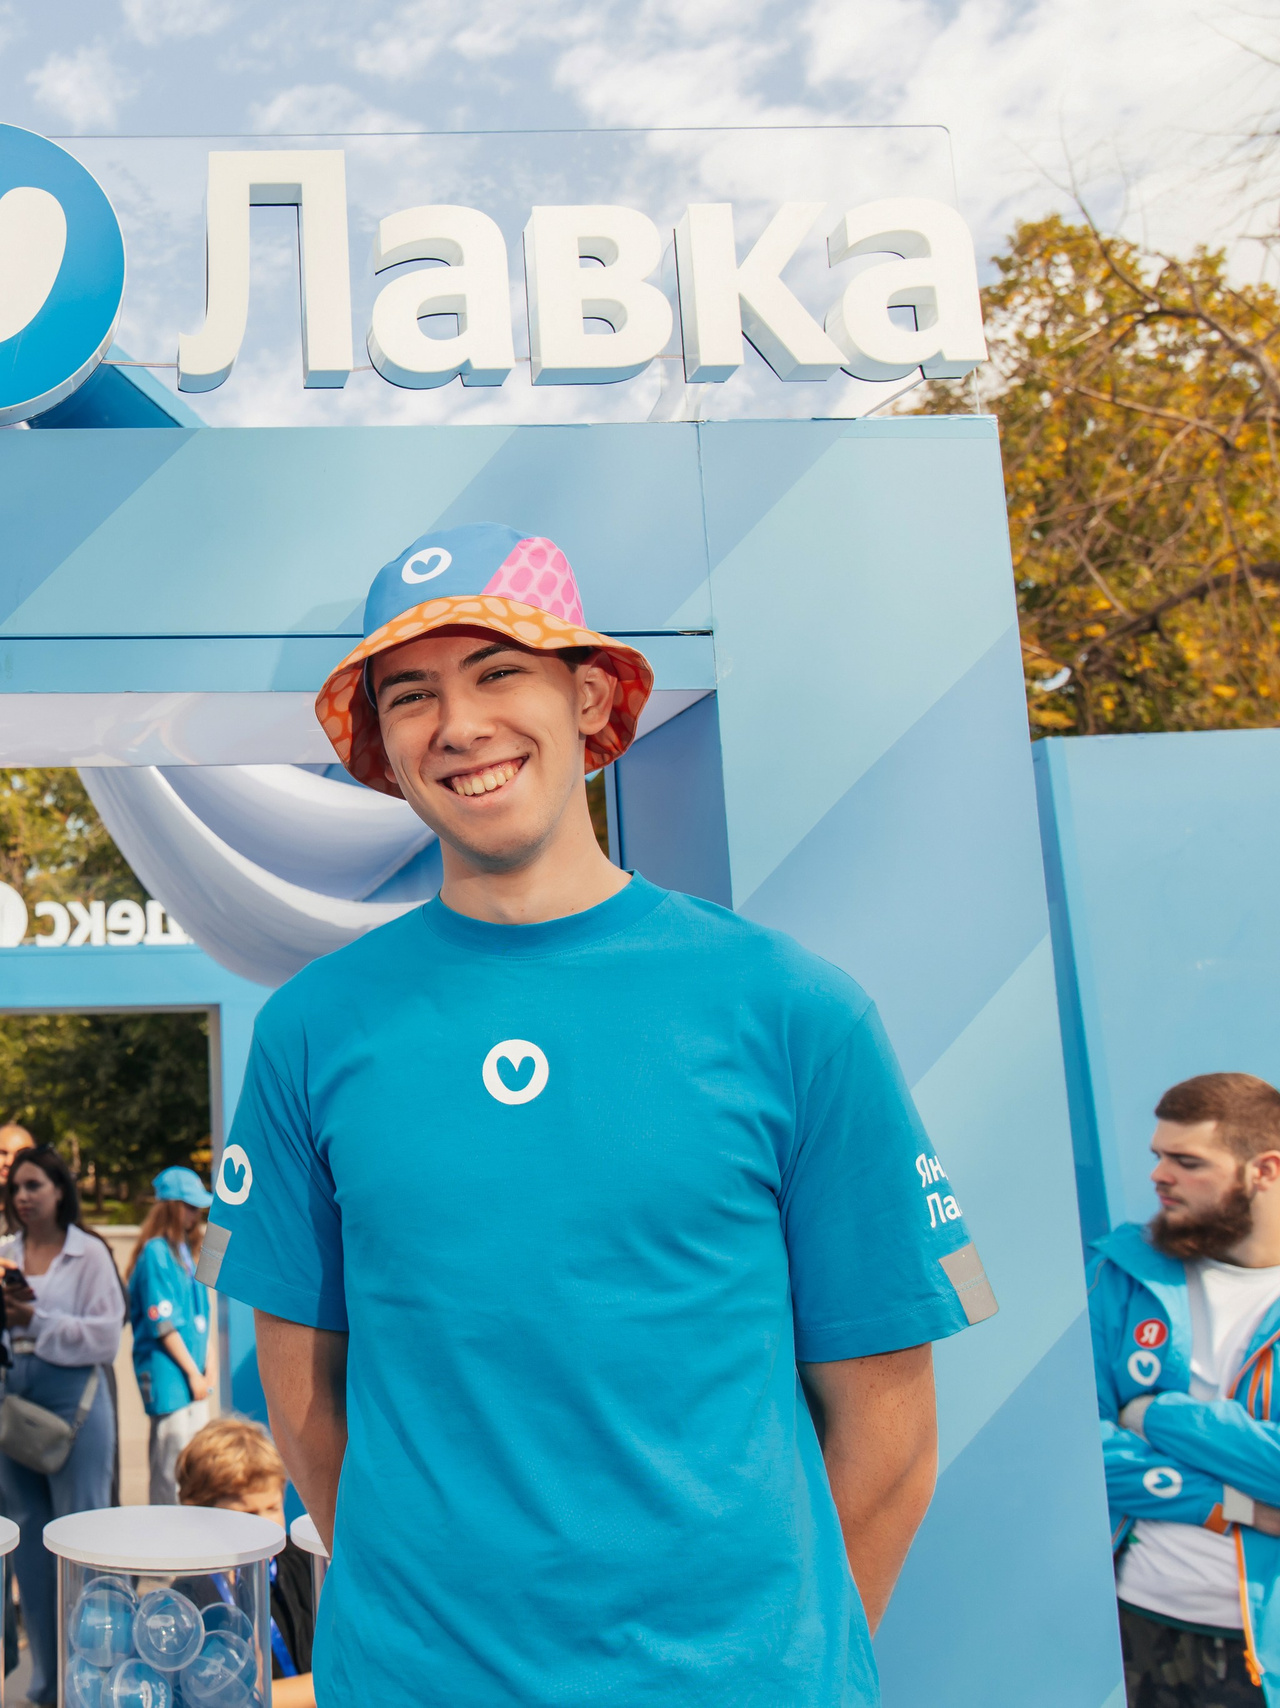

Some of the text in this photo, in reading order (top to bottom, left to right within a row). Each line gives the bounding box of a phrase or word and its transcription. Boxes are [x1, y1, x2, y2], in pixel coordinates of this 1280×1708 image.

[177, 149, 989, 393] Лавка
[915, 1153, 949, 1188] Ян
[926, 1192, 963, 1228] Ла
